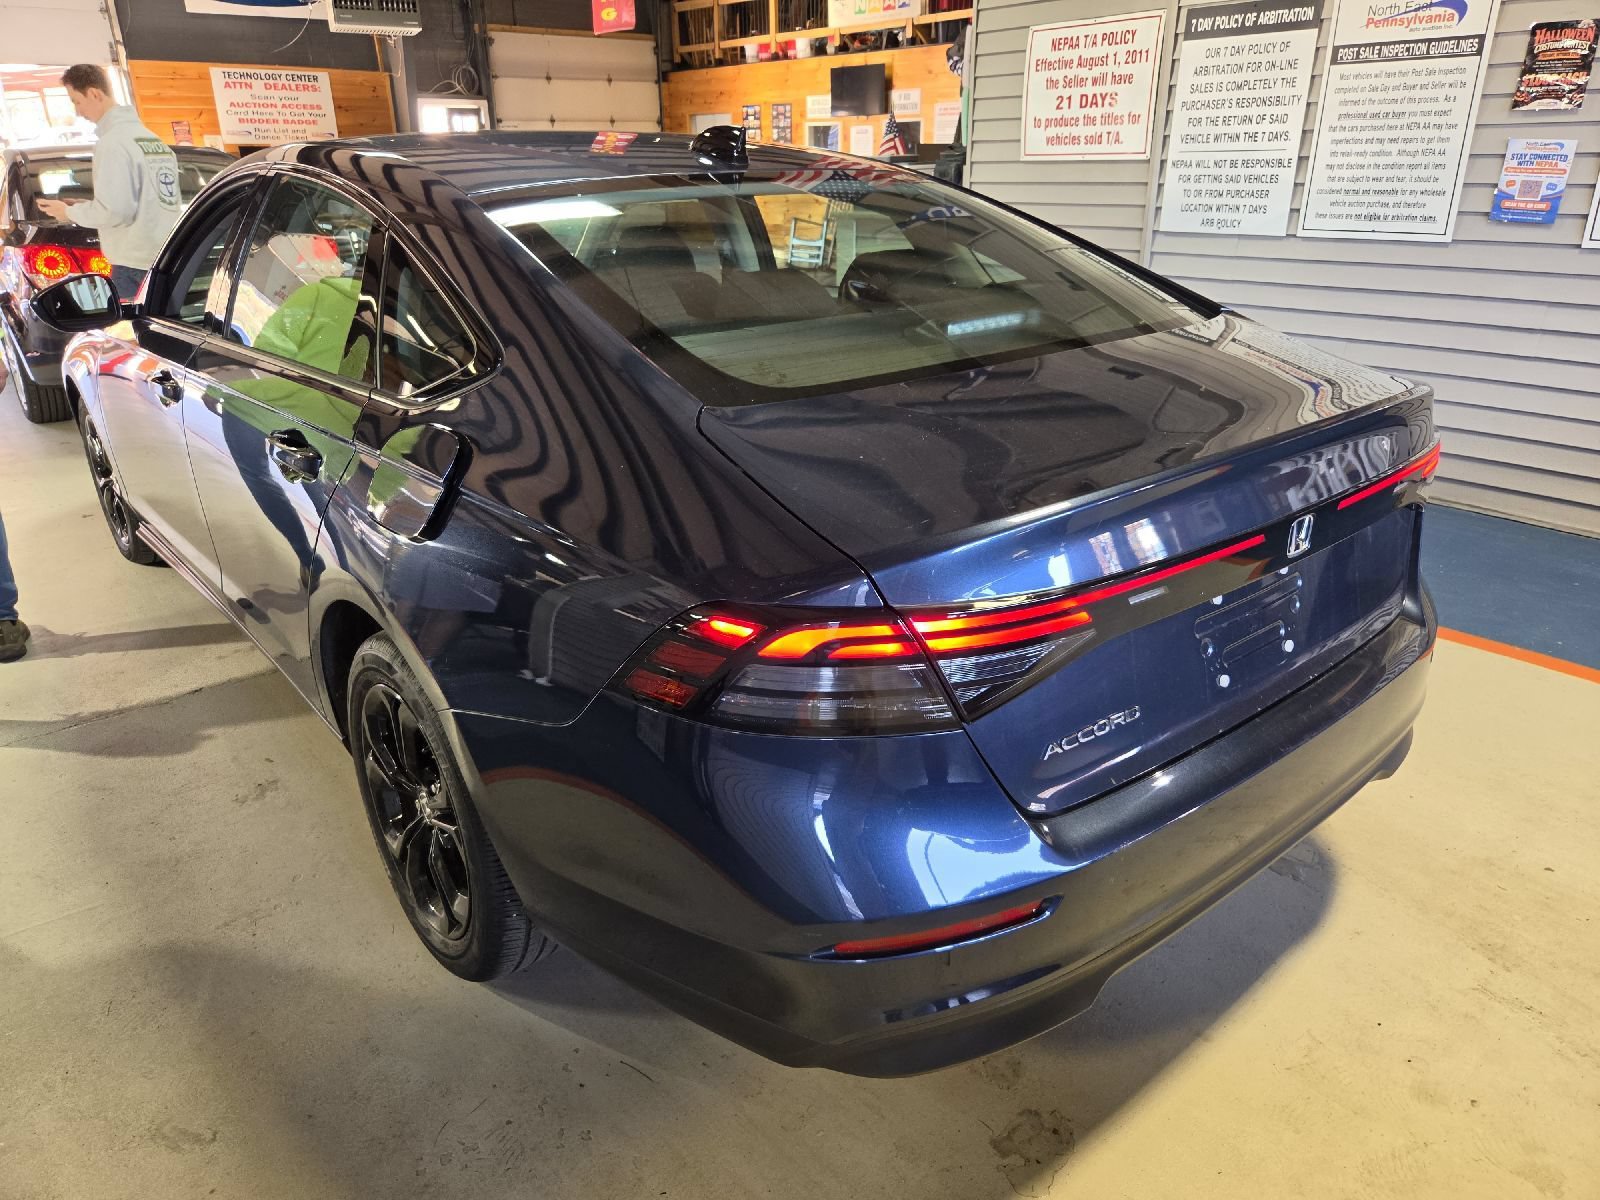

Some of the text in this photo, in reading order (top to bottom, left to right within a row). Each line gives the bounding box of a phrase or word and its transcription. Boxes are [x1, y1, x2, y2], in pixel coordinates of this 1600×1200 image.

[1368, 0, 1433, 17] North East
[1191, 6, 1314, 32] 7 DAY POLICY OF ARBITRATION
[1366, 11, 1455, 29] Pennsylvania
[1051, 30, 1137, 52] NEPAA T/A POLICY
[1534, 26, 1596, 45] HALLOWEEN
[1206, 41, 1291, 58] OUR 7 DAY POLICY OF
[1338, 39, 1479, 60] POST SALE INSPECTION GUIDELINES
[1036, 48, 1149, 72] Effective August 1, 2011
[1193, 59, 1299, 77] ARBITRATION FOR ON-LINE
[1412, 68, 1423, 76] Post
[1425, 68, 1436, 76] Sale
[1438, 67, 1466, 77] Inspection
[222, 71, 318, 83] TECHNOLOGY CENTER
[1046, 72, 1133, 90] the Seller will have
[264, 83, 321, 92] DEALERS:
[1190, 77, 1297, 94] SALES IS COMPLETELY THE
[1056, 92, 1118, 110] 21 DAYS
[1181, 95, 1302, 111] PURCHASER'S RESPONSIBILITY
[1034, 112, 1141, 130] to produce the titles for
[1188, 113, 1288, 127] FOR THE RETURN OF SAID
[1338, 110, 1368, 121] professional
[1370, 110, 1381, 118] used
[1392, 110, 1406, 120] buyer
[1434, 108, 1452, 118] expect
[1046, 131, 1123, 146] vehicles sold T/A.
[1181, 131, 1291, 144] VEHICLE WITHIN THE 7 DAYS.
[1171, 158, 1292, 168] NEPAA WILL NOT BE RESPONSIBLE
[1529, 154, 1568, 162] CONNECTED
[1178, 174, 1279, 183] FOR GETTING SAID VEHICLES
[1183, 189, 1269, 198] TO OR FROM PURCHASER
[1409, 189, 1418, 198] any
[1420, 188, 1446, 196] wholesale
[1181, 204, 1267, 214] LOCATION WITHIN 7 DAYS
[1330, 199, 1346, 207] vehicle
[1200, 219, 1242, 228] ARB POLICY
[1354, 212, 1362, 220] not
[1364, 212, 1381, 221] eligible
[1392, 213, 1417, 221] arbitration
[1419, 214, 1437, 222] claims.
[1043, 706, 1140, 760] ACCORD
